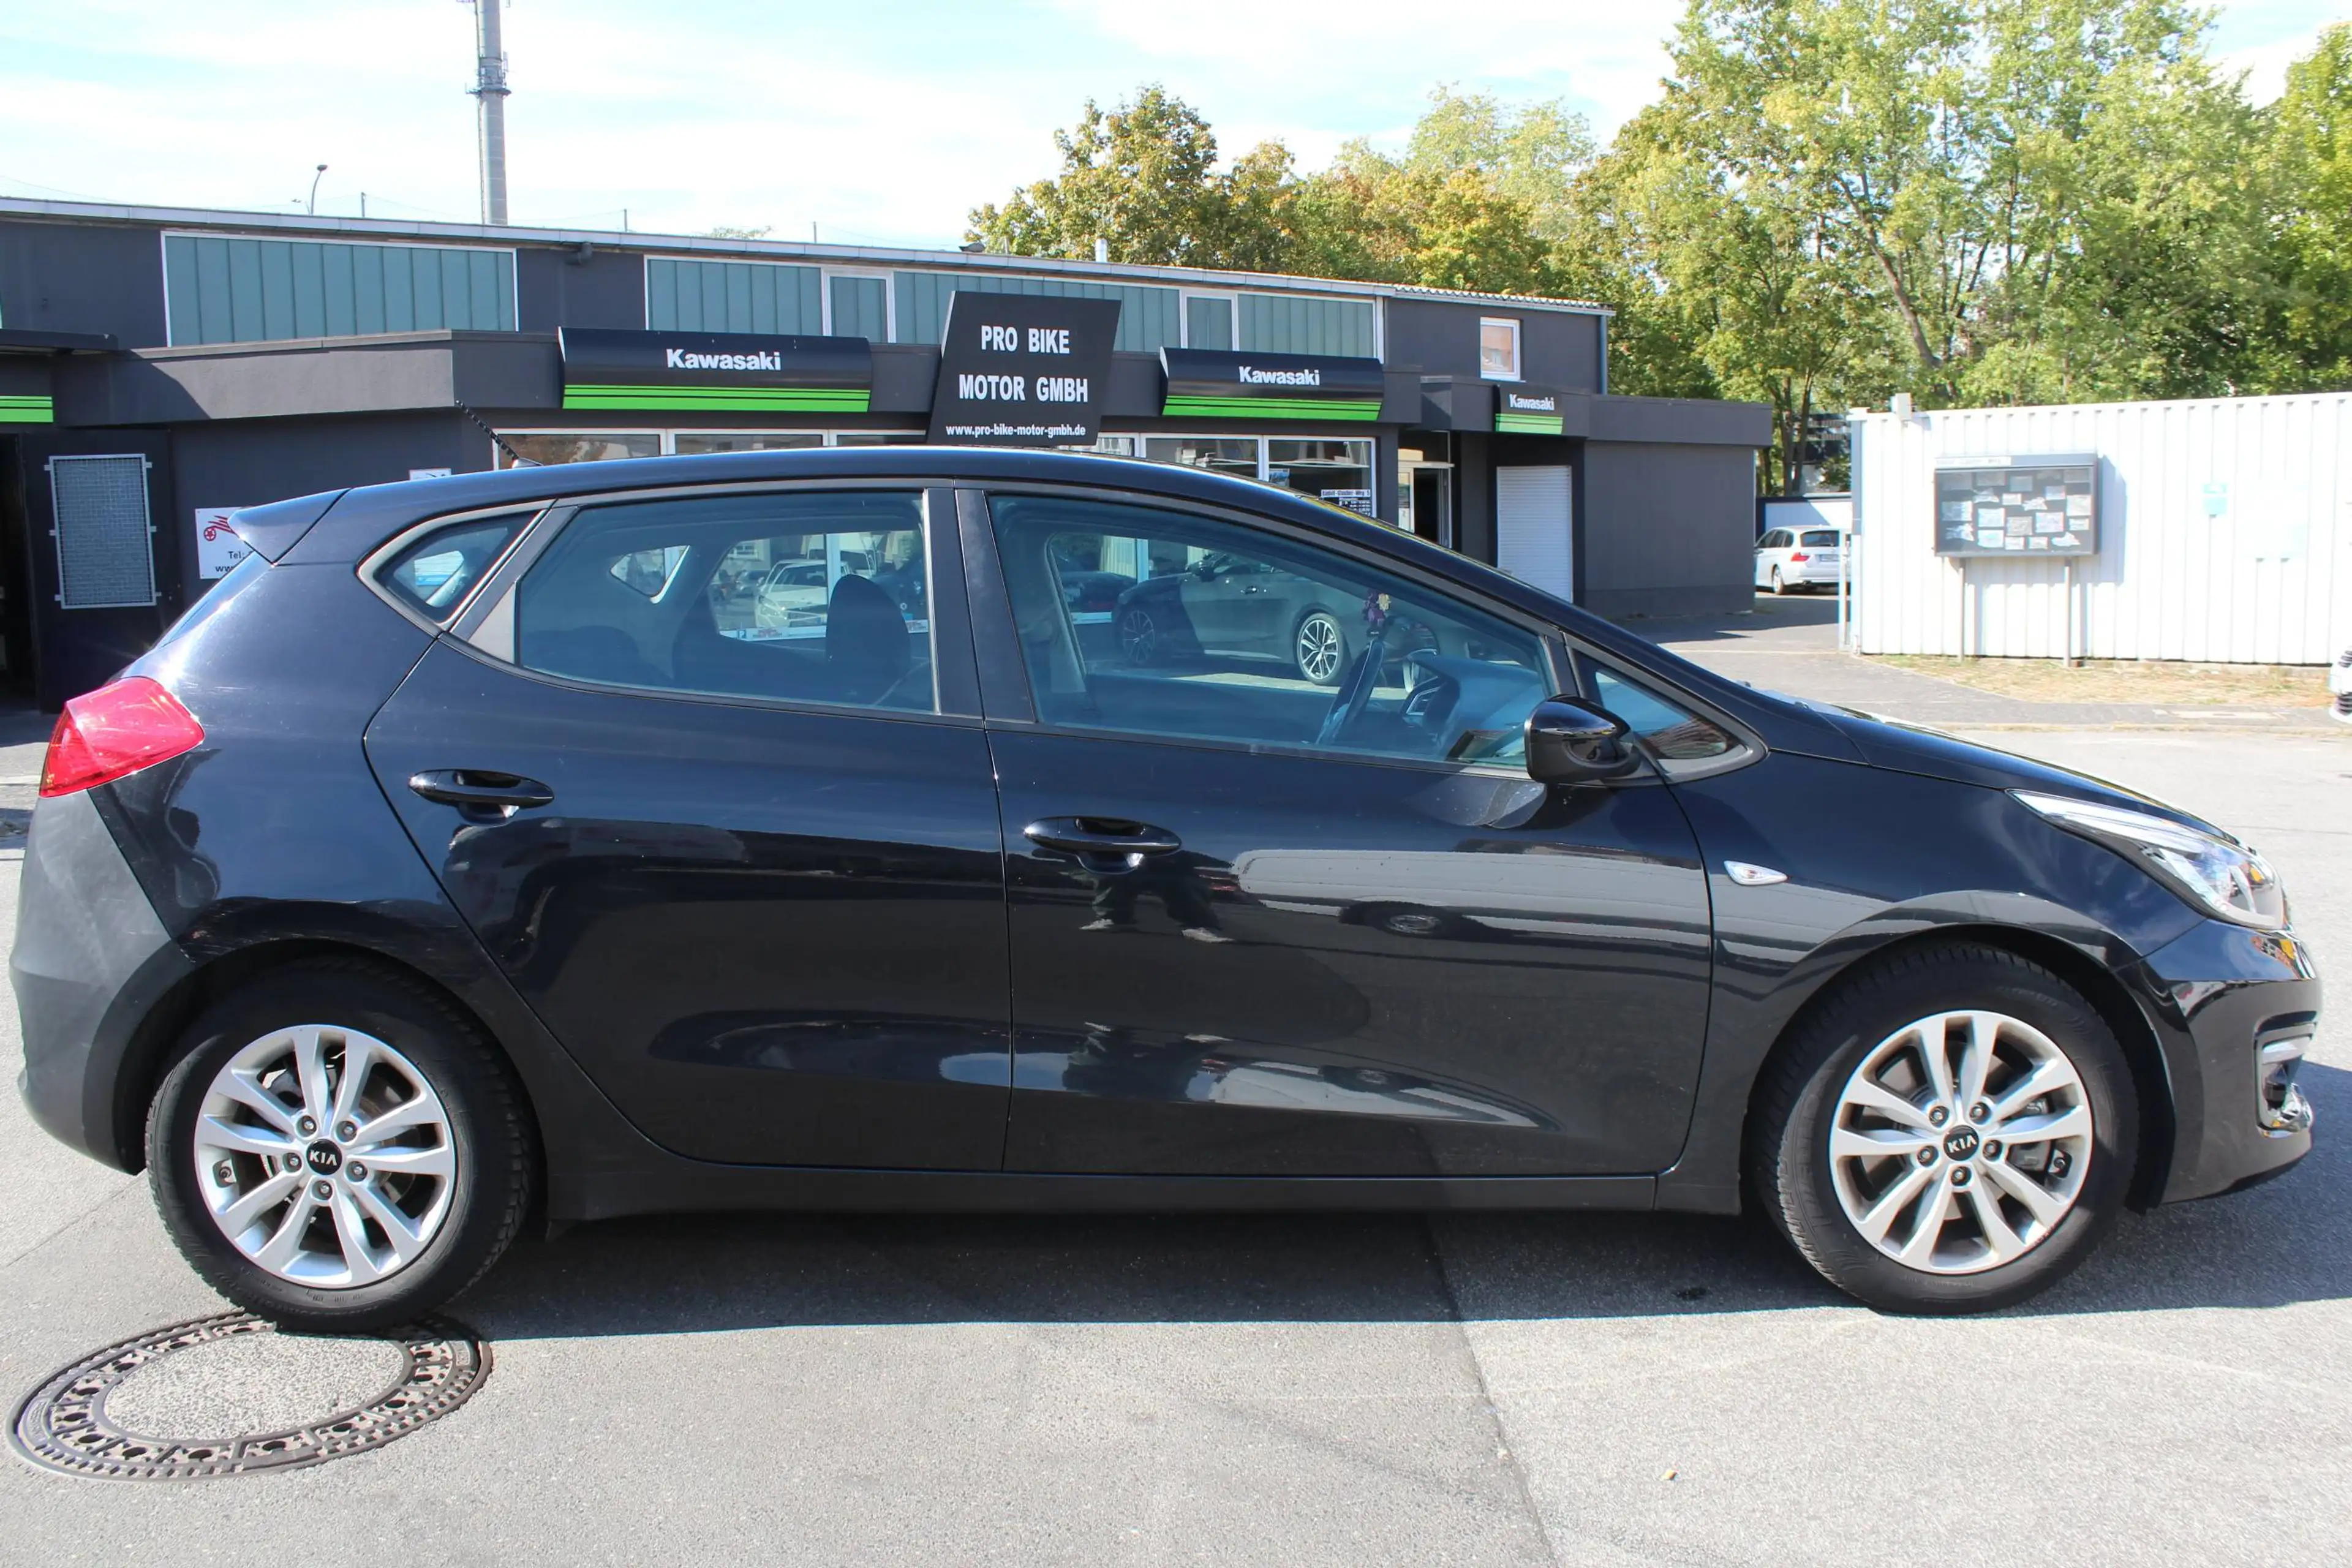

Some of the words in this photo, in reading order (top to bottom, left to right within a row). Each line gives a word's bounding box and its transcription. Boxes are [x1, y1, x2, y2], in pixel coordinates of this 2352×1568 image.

[981, 325, 1017, 352] PRO
[1028, 328, 1070, 355] BIKE
[666, 349, 782, 371] Kawasaki
[1238, 366, 1321, 386] Kawasaki
[959, 374, 1025, 401] MOTOR
[1036, 377, 1088, 402] GMBH
[1509, 393, 1555, 412] Kawasaki
[945, 423, 1086, 439] www.pro-bike-motor-gmbh.de
[1947, 1134, 1977, 1153] KIA
[309, 1149, 337, 1166] KIA
